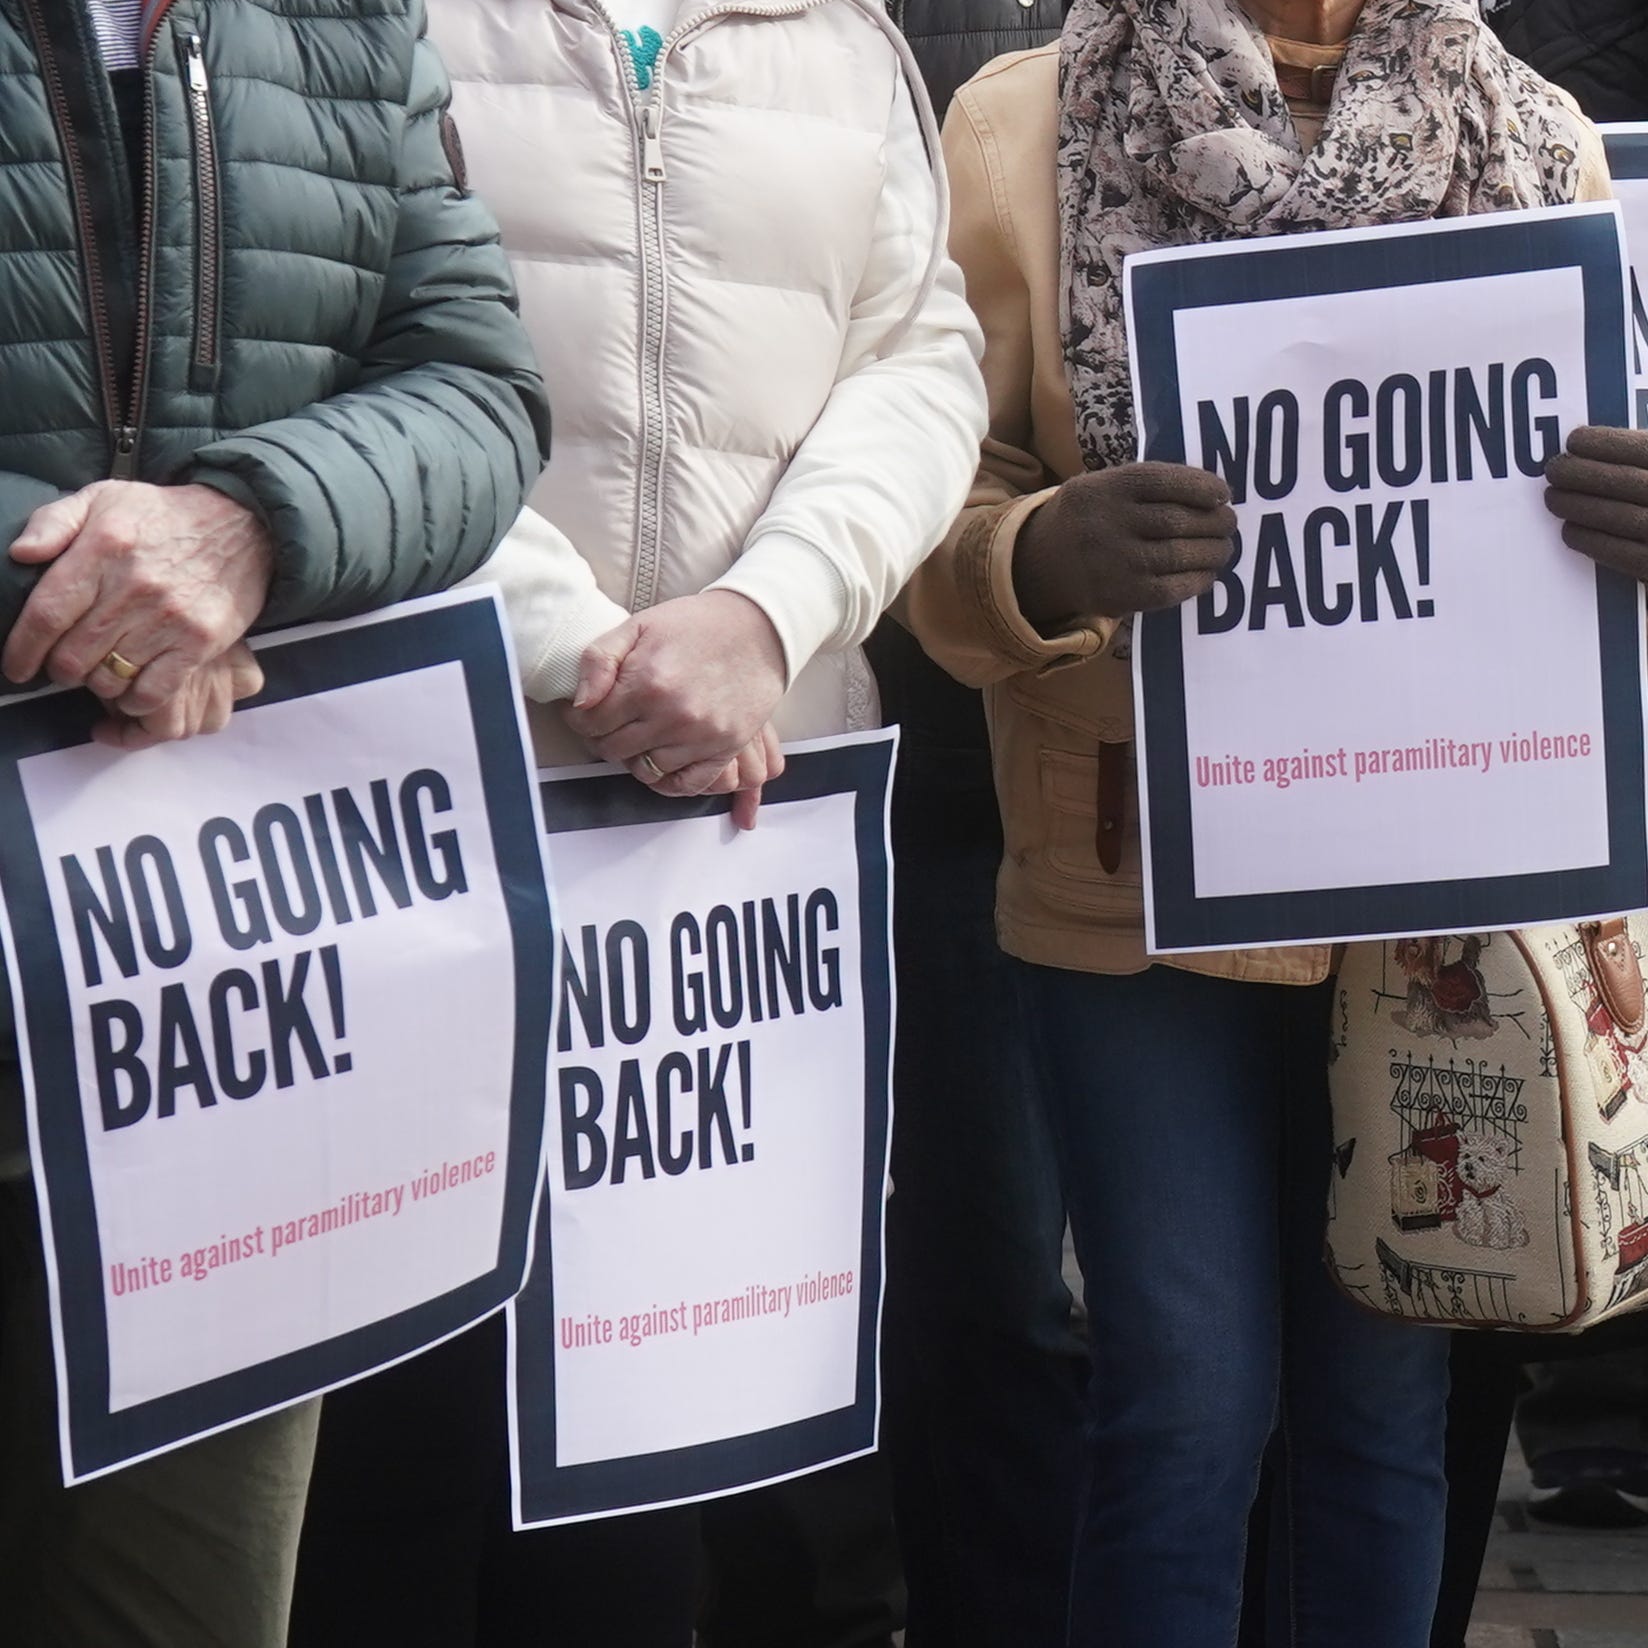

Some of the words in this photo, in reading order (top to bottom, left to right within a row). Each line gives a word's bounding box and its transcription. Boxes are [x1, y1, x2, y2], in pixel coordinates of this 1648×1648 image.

[1198, 389, 1299, 504] NO
[1324, 358, 1561, 492] GOING
[1195, 756, 1256, 788] Unite
[1262, 748, 1348, 789] against
[1353, 739, 1492, 782] paramilitary
[1499, 731, 1591, 763] violence
[61, 836, 191, 987] NO
[199, 769, 468, 950] GOING
[89, 945, 352, 1131] BACK!
[557, 920, 650, 1052] NO
[671, 888, 842, 1036] GOING
[559, 1040, 754, 1190] BACK!
[109, 1257, 173, 1297] Unite
[179, 1227, 265, 1281] against
[270, 1186, 404, 1257] paramilitary
[410, 1151, 496, 1201] violence
[560, 1317, 613, 1350] Unite
[618, 1303, 688, 1348] against
[692, 1287, 791, 1331] paramilitary
[797, 1271, 854, 1303] violence
